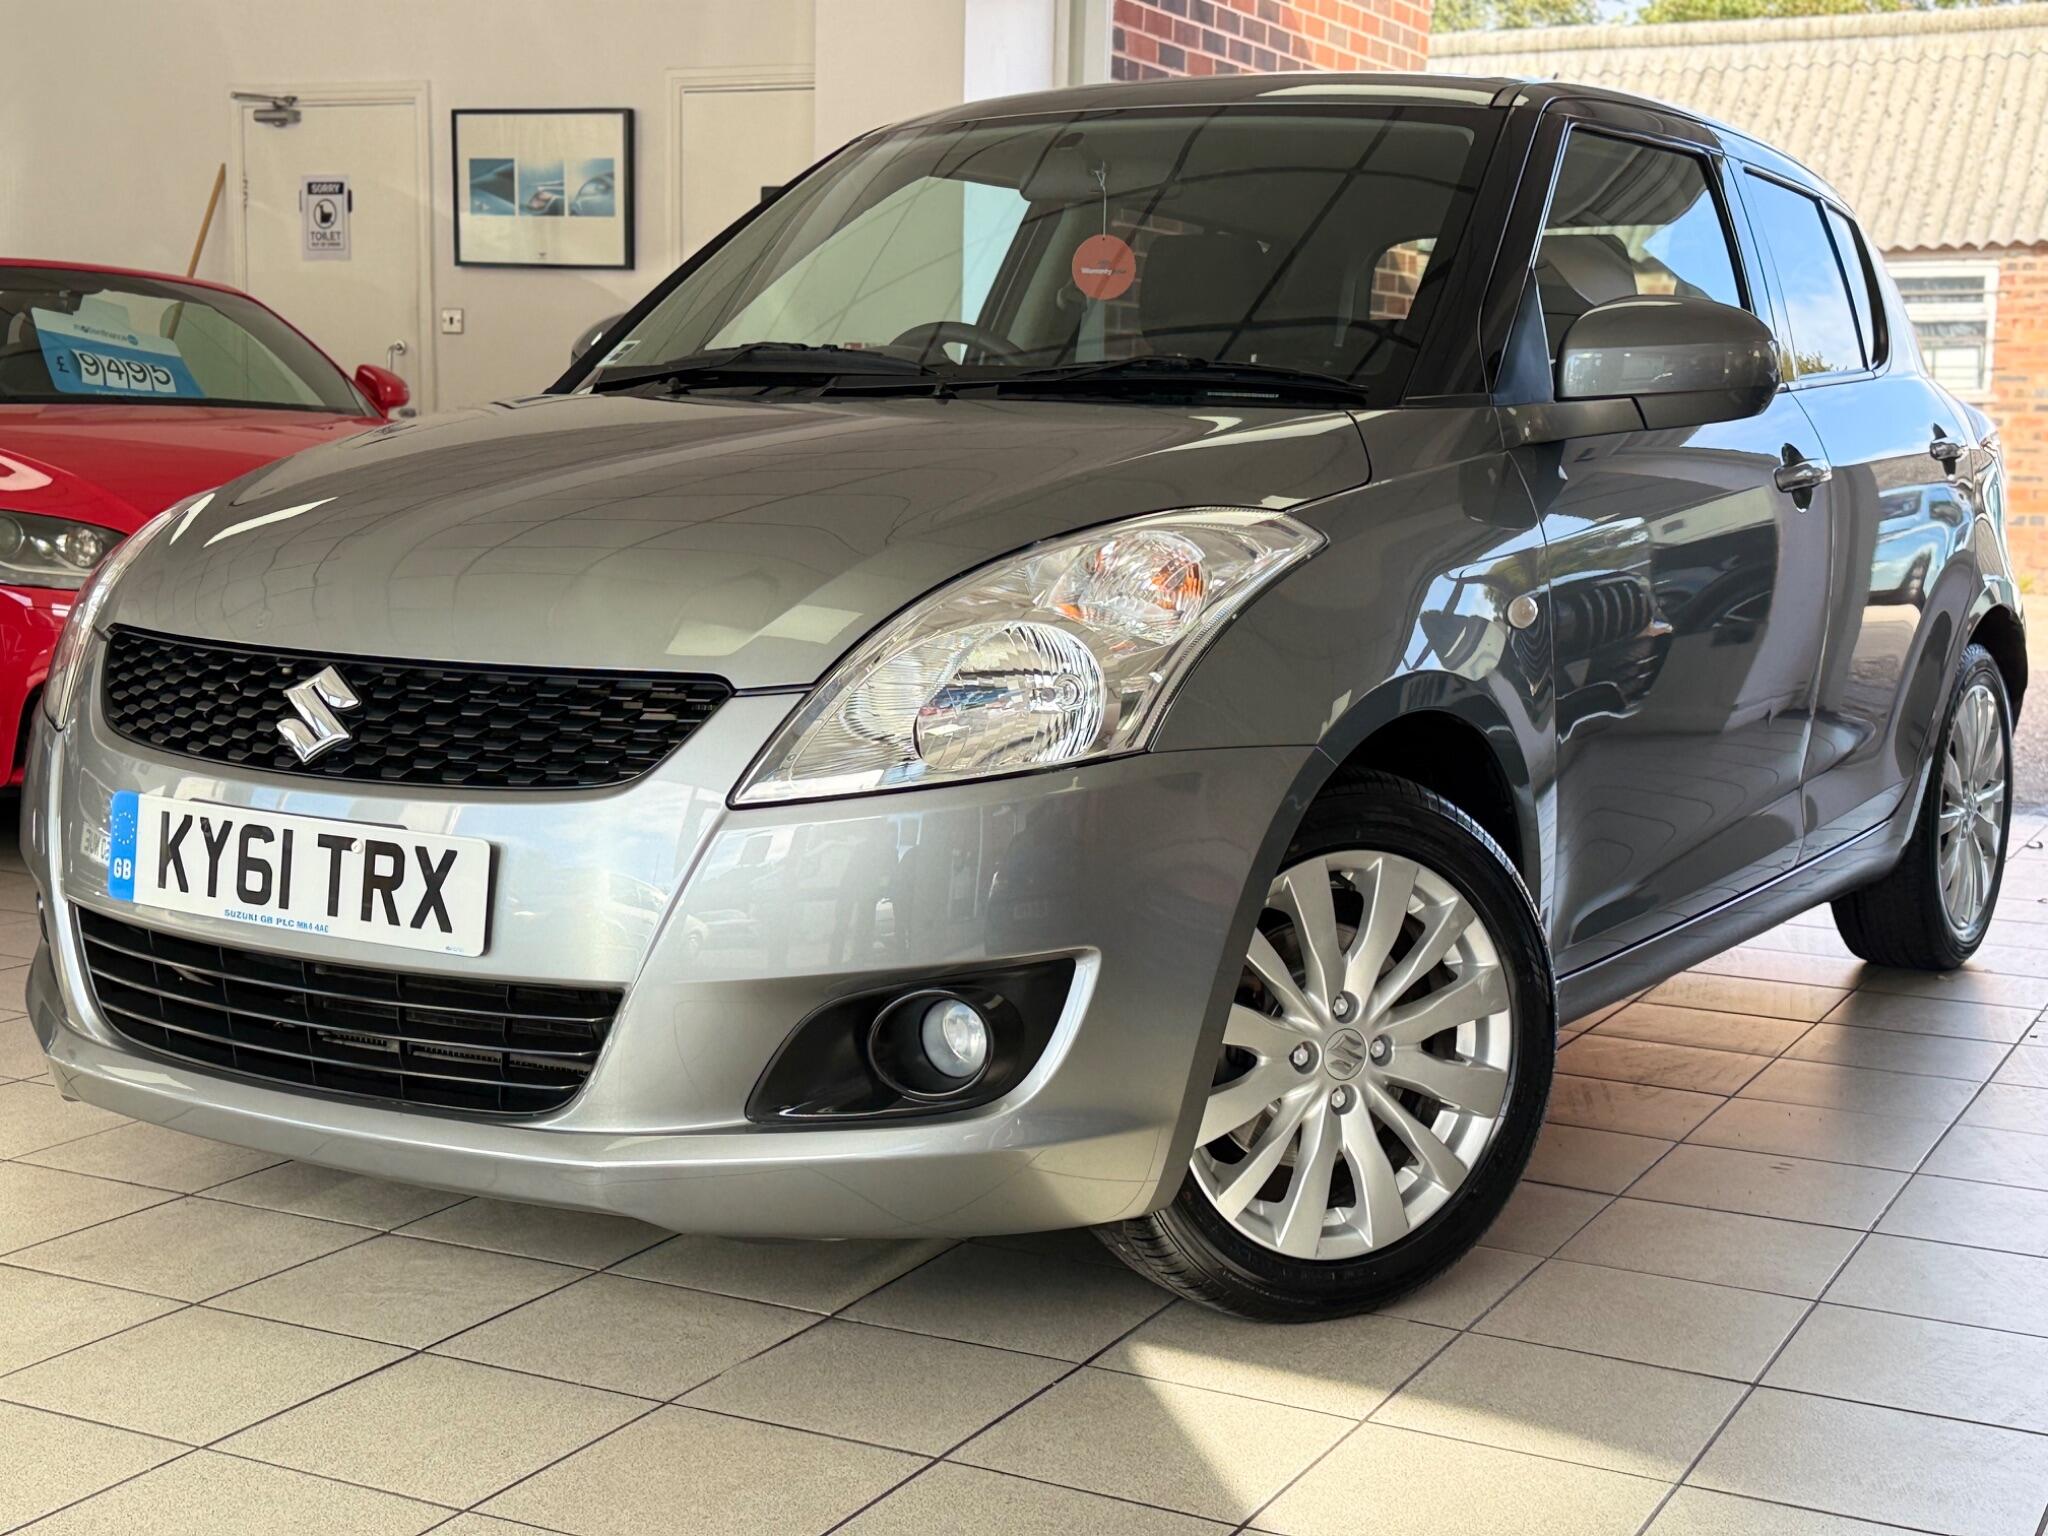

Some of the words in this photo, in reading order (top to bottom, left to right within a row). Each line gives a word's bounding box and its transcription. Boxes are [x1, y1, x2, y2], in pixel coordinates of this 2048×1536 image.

[311, 231, 341, 241] TOILET
[79, 353, 171, 385] 9495
[113, 857, 132, 881] GB
[158, 811, 293, 910] KY61
[318, 833, 458, 934] TRX
[224, 909, 258, 921] SUZUKI
[260, 915, 273, 924] GB
[276, 917, 295, 928] PLC
